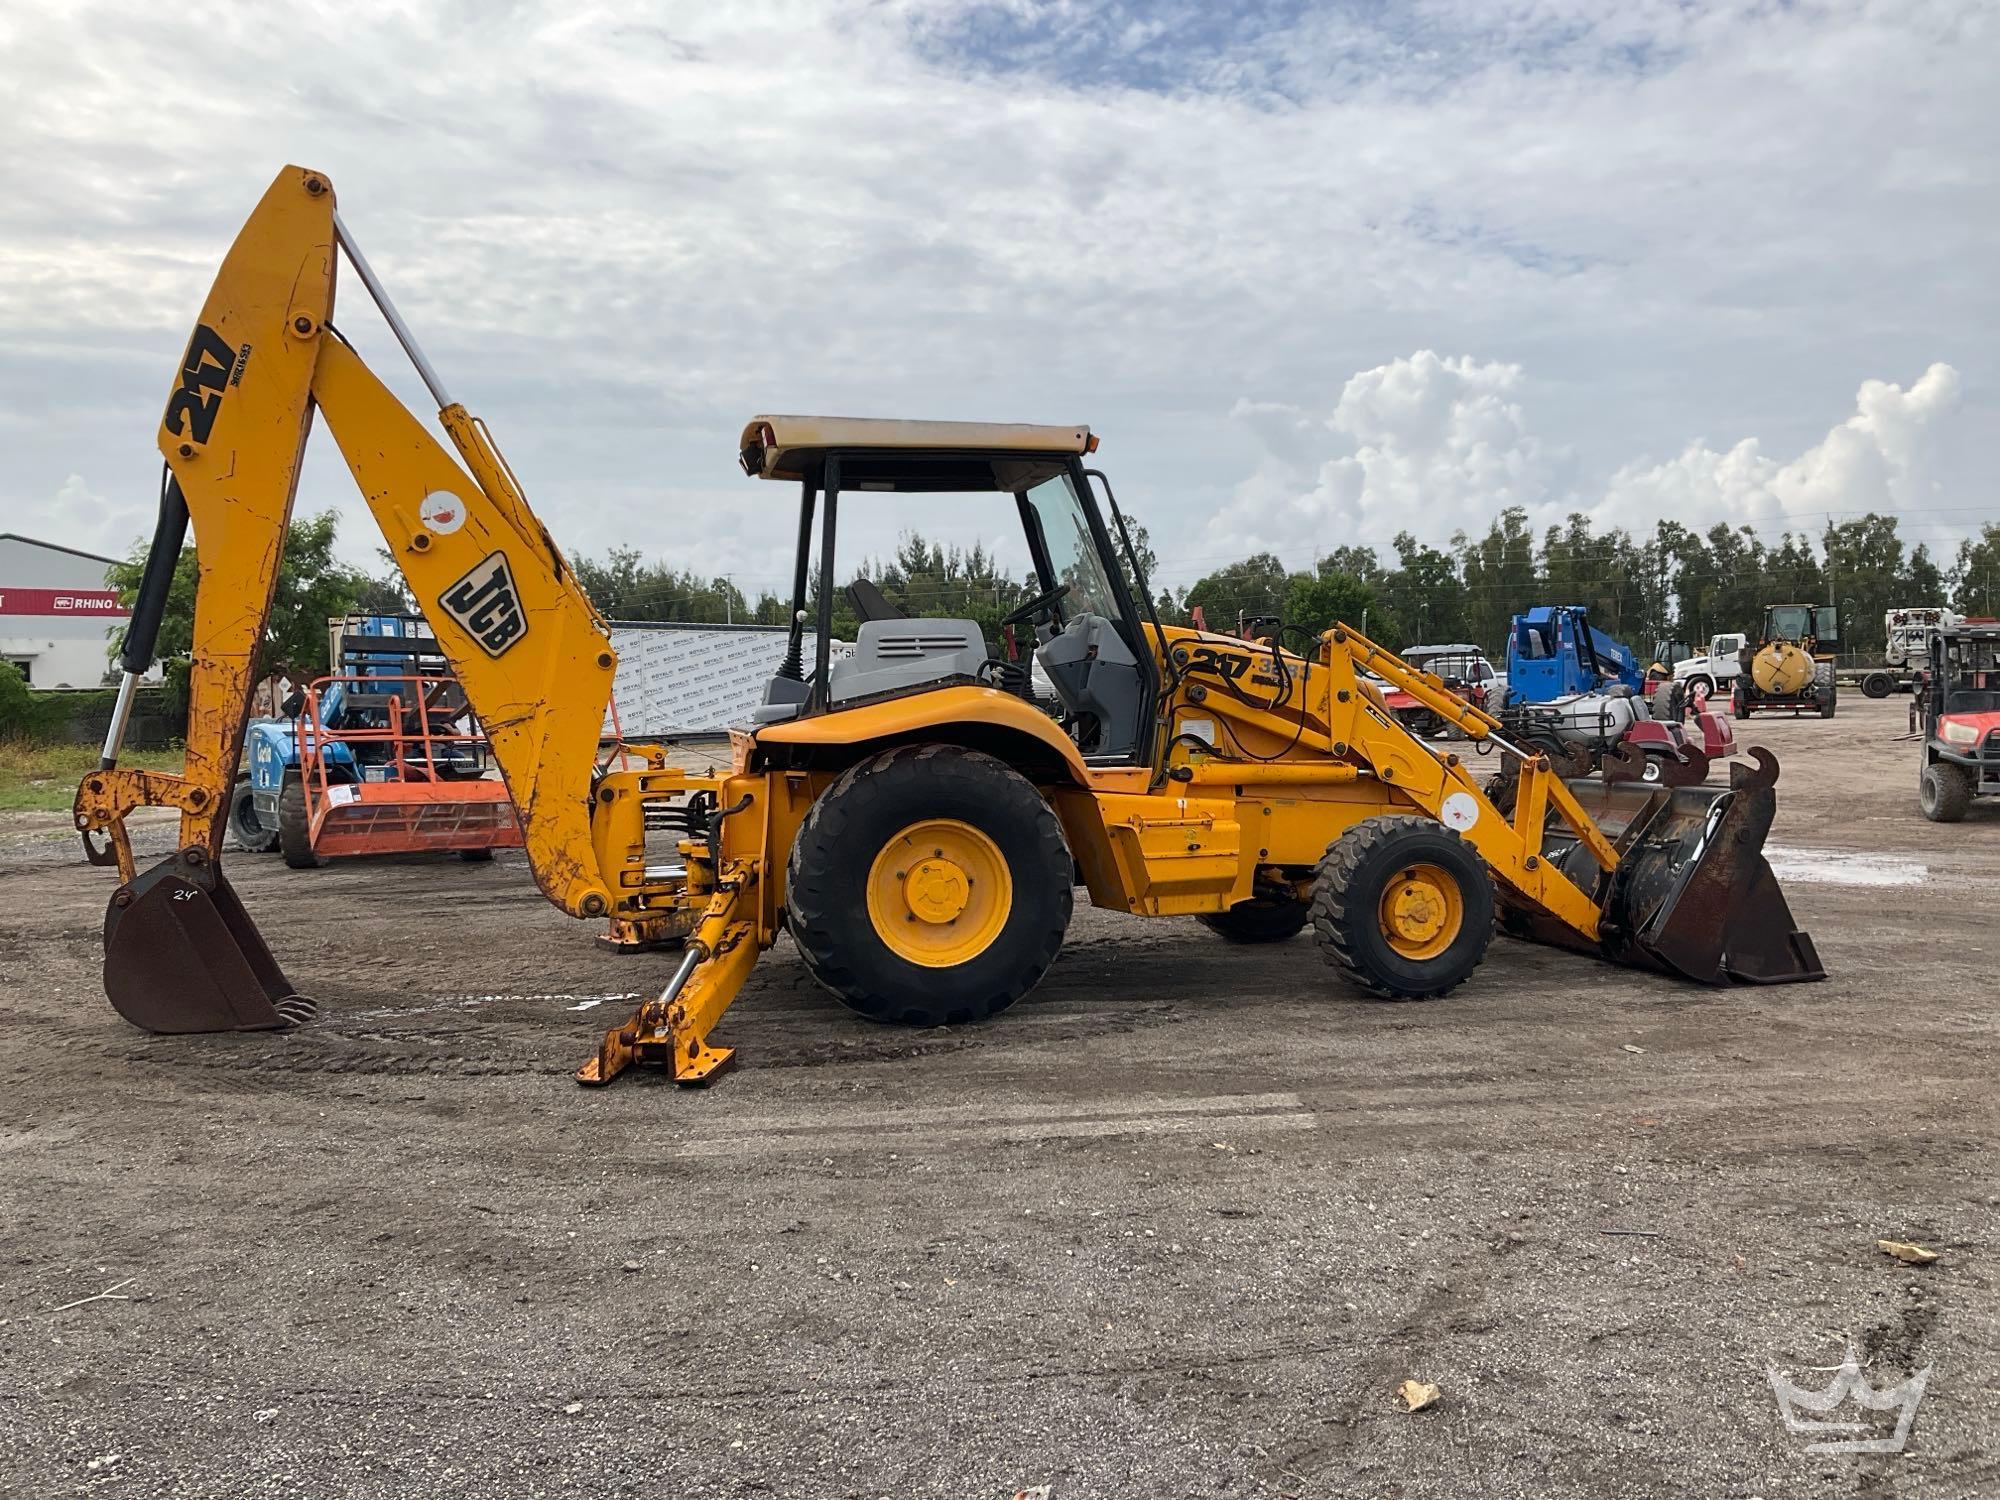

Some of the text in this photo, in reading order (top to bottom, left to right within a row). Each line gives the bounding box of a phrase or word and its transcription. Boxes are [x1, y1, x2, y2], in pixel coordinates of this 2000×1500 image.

[165, 323, 236, 445] 217
[74, 598, 113, 609] RHINO
[446, 565, 522, 650] JCB
[1193, 648, 1252, 679] 217
